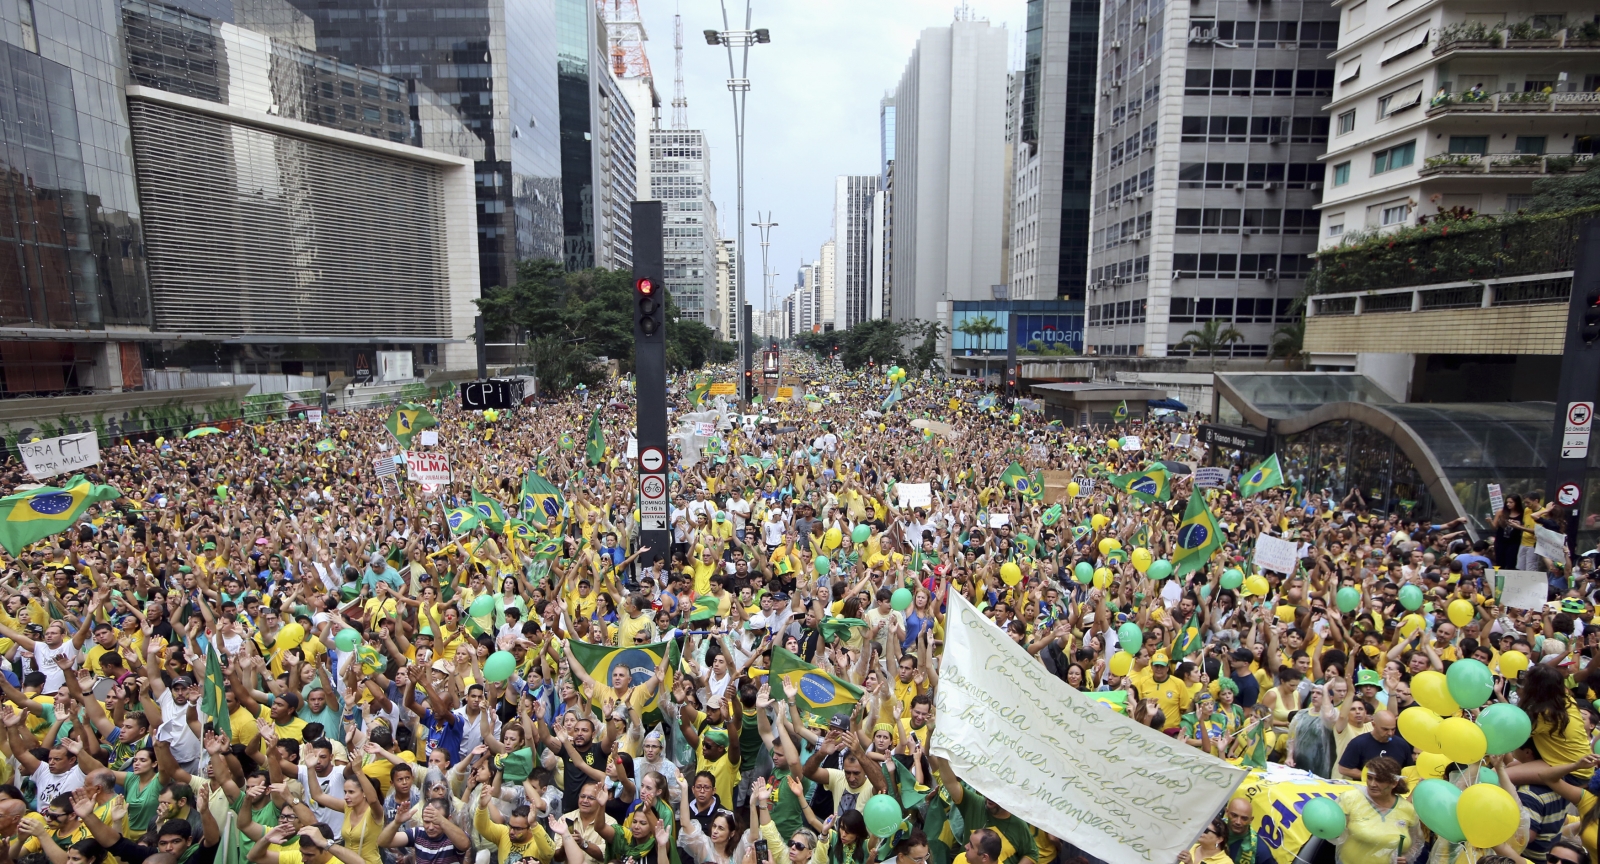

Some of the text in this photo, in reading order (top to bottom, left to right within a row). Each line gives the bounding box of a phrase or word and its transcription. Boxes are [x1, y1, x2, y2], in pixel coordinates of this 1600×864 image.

[20, 437, 86, 458] FORA PT
[406, 451, 447, 462] FORA
[34, 454, 90, 473] FORA MALUF
[407, 460, 450, 472] DILMA
[1060, 696, 1103, 725] são
[1090, 746, 1126, 764] do
